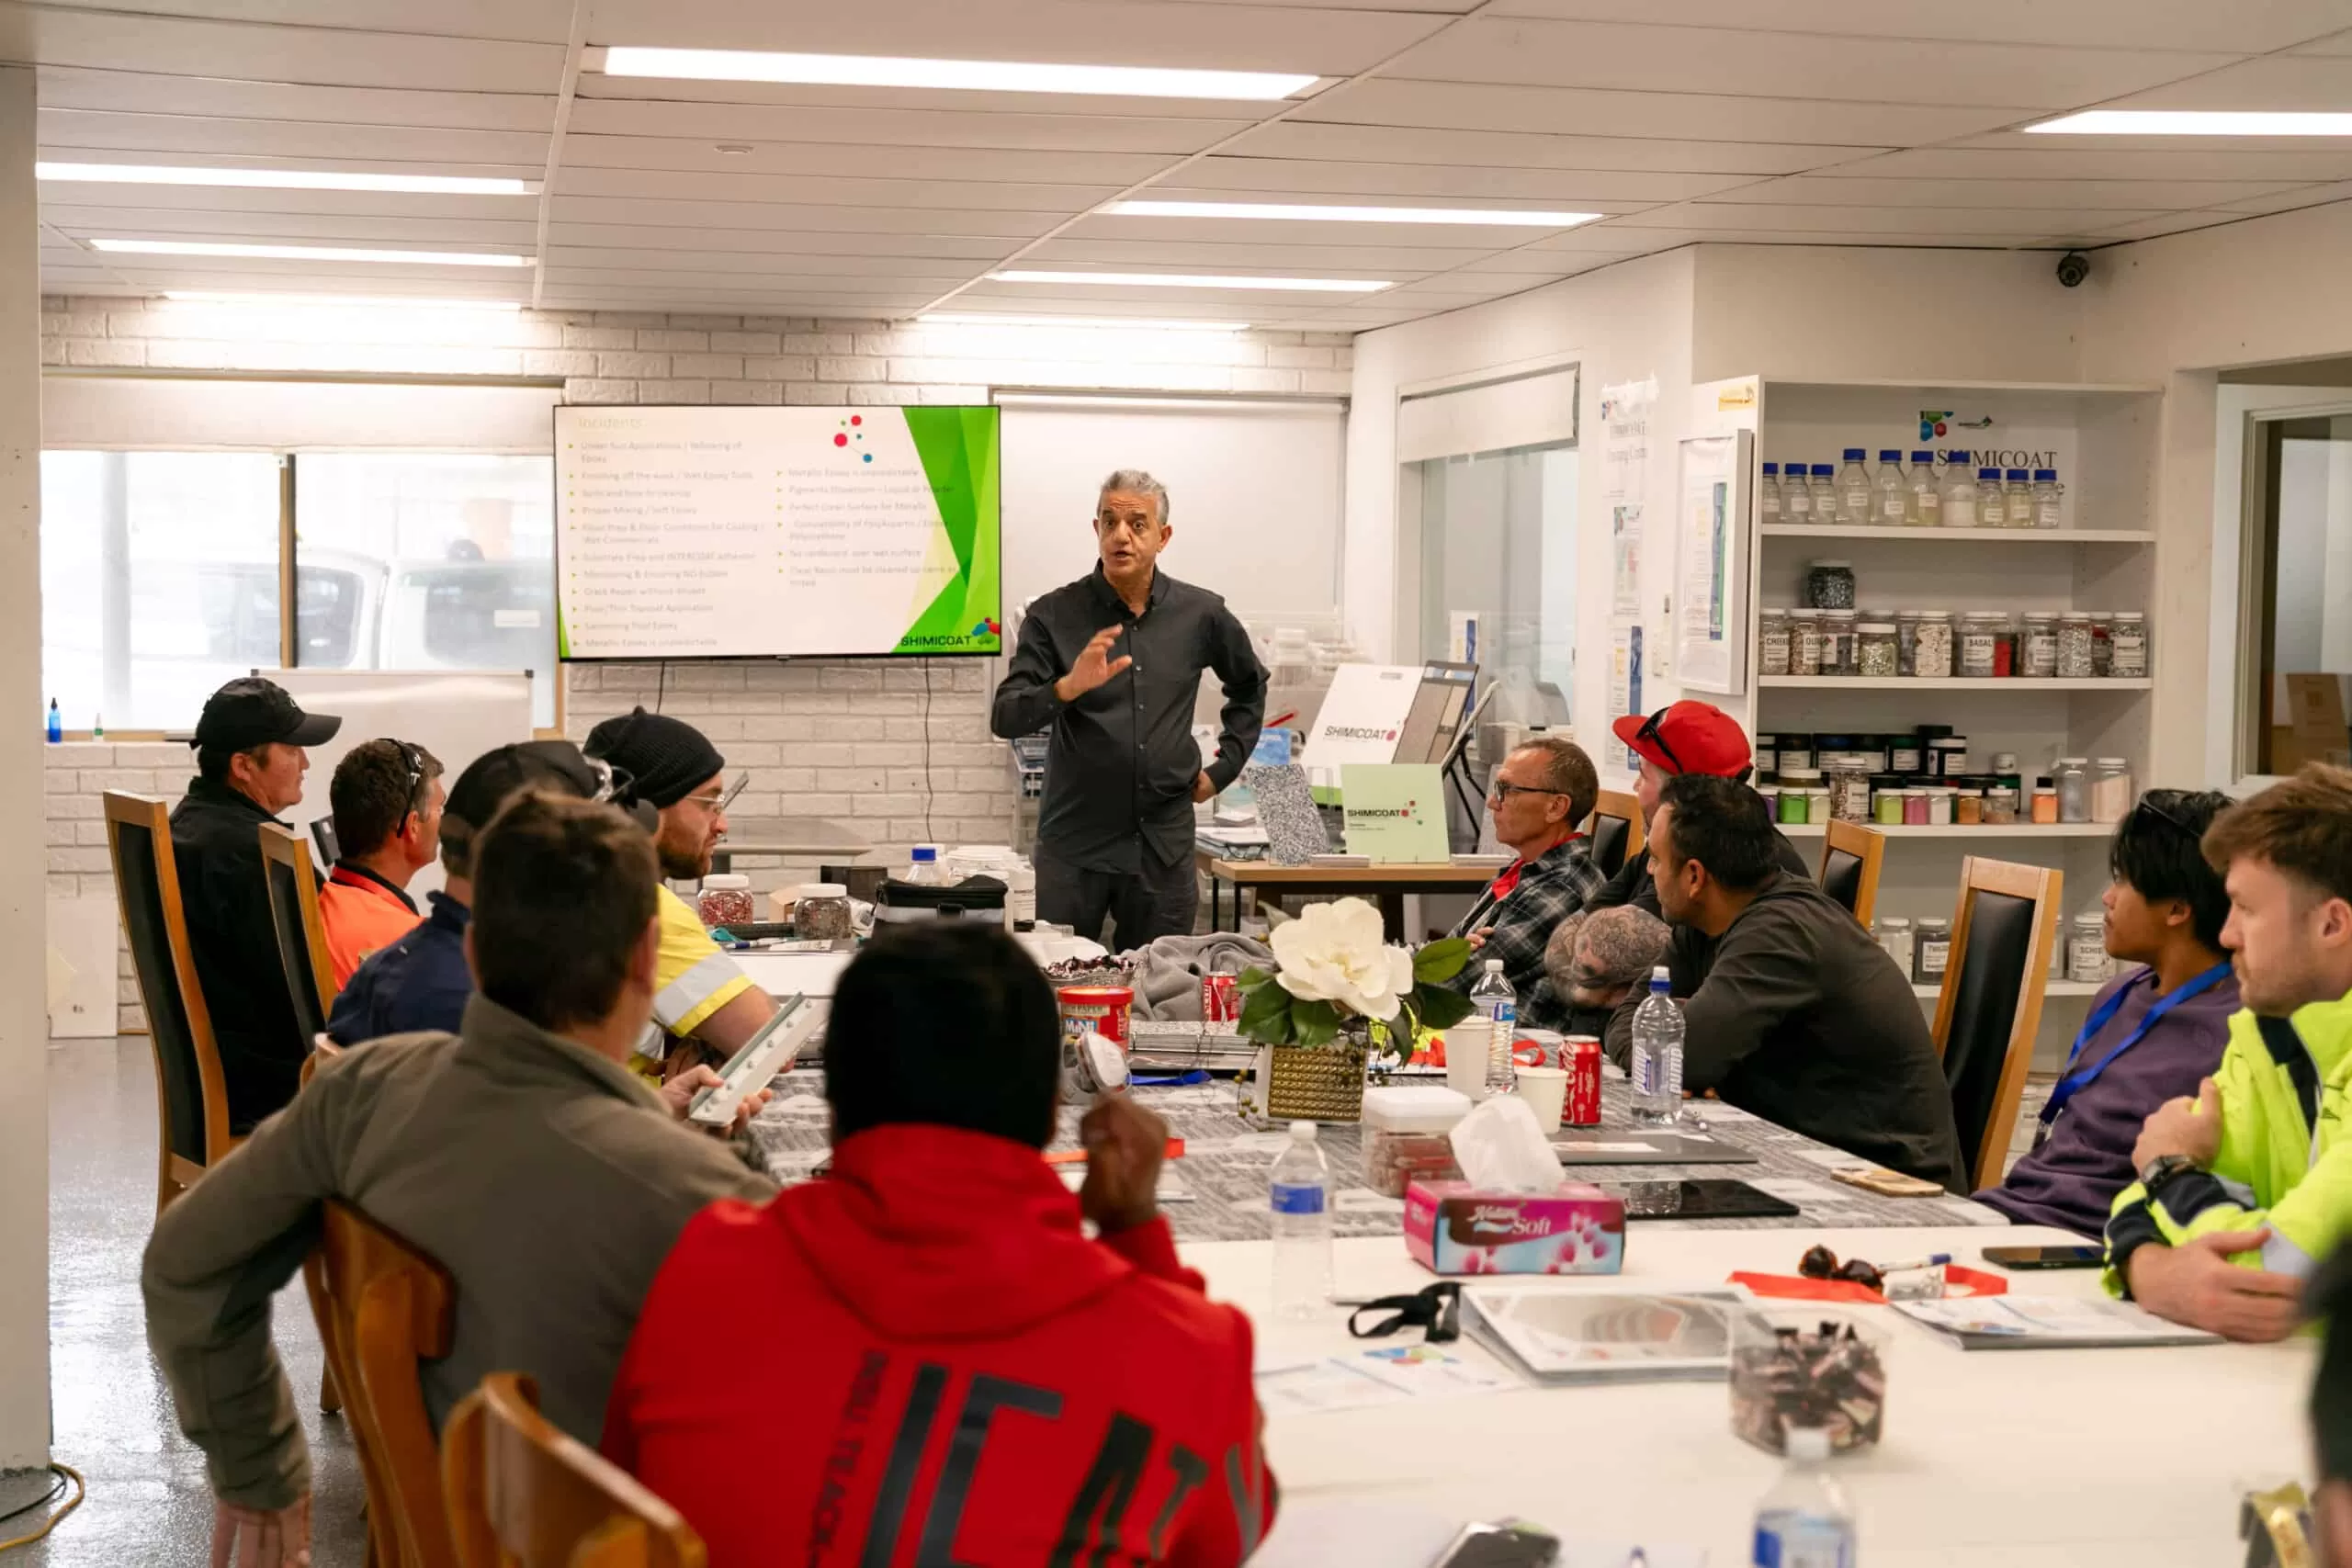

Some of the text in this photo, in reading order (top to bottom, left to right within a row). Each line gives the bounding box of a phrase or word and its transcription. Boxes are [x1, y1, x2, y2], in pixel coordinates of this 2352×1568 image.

[900, 635, 970, 646] SHIMICOAT
[1324, 726, 1387, 739] SHIMICOAT
[1347, 809, 1400, 818] SHIMICOAT
[1511, 1217, 1551, 1235] Soft
